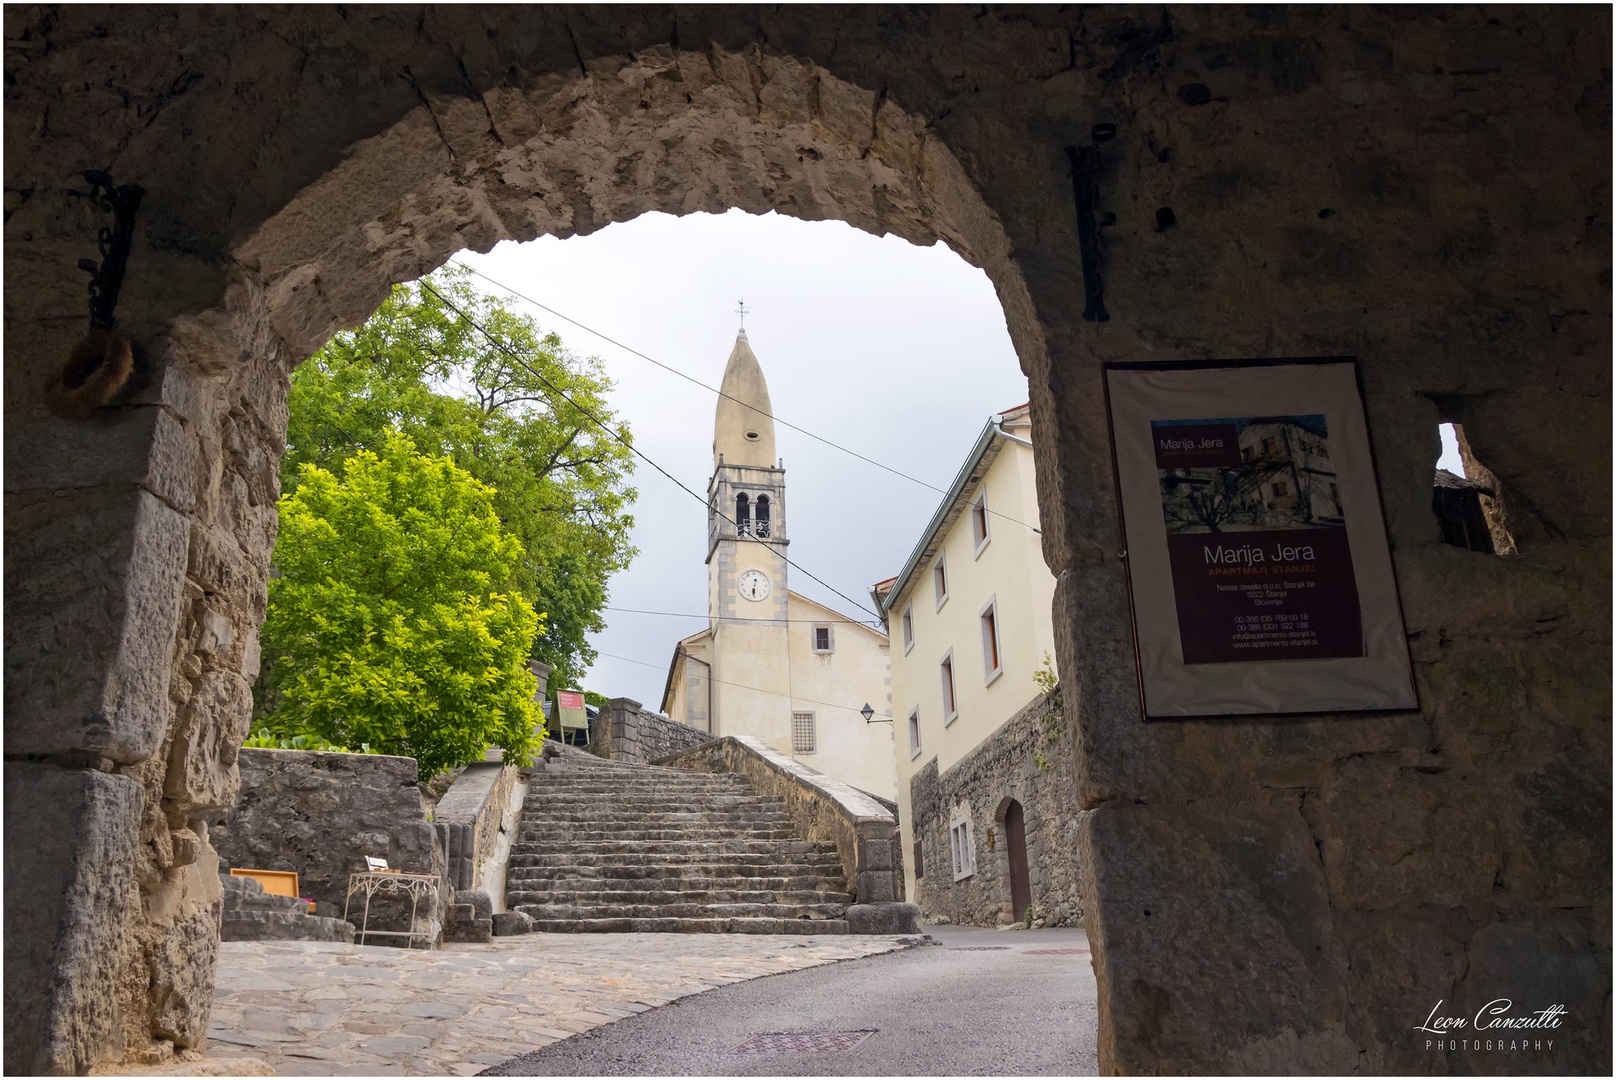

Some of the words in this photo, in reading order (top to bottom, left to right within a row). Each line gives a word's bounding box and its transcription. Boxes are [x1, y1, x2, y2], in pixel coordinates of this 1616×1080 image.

[1160, 438, 1195, 451] Marija
[1197, 438, 1224, 449] Jera
[1203, 544, 1266, 567] Marija
[1270, 543, 1316, 562] Jera
[1208, 566, 1268, 577] APARTMAJI
[1234, 616, 1244, 624] 00
[1300, 613, 1309, 621] 18
[1236, 624, 1247, 632] 00
[1280, 622, 1294, 630] 522
